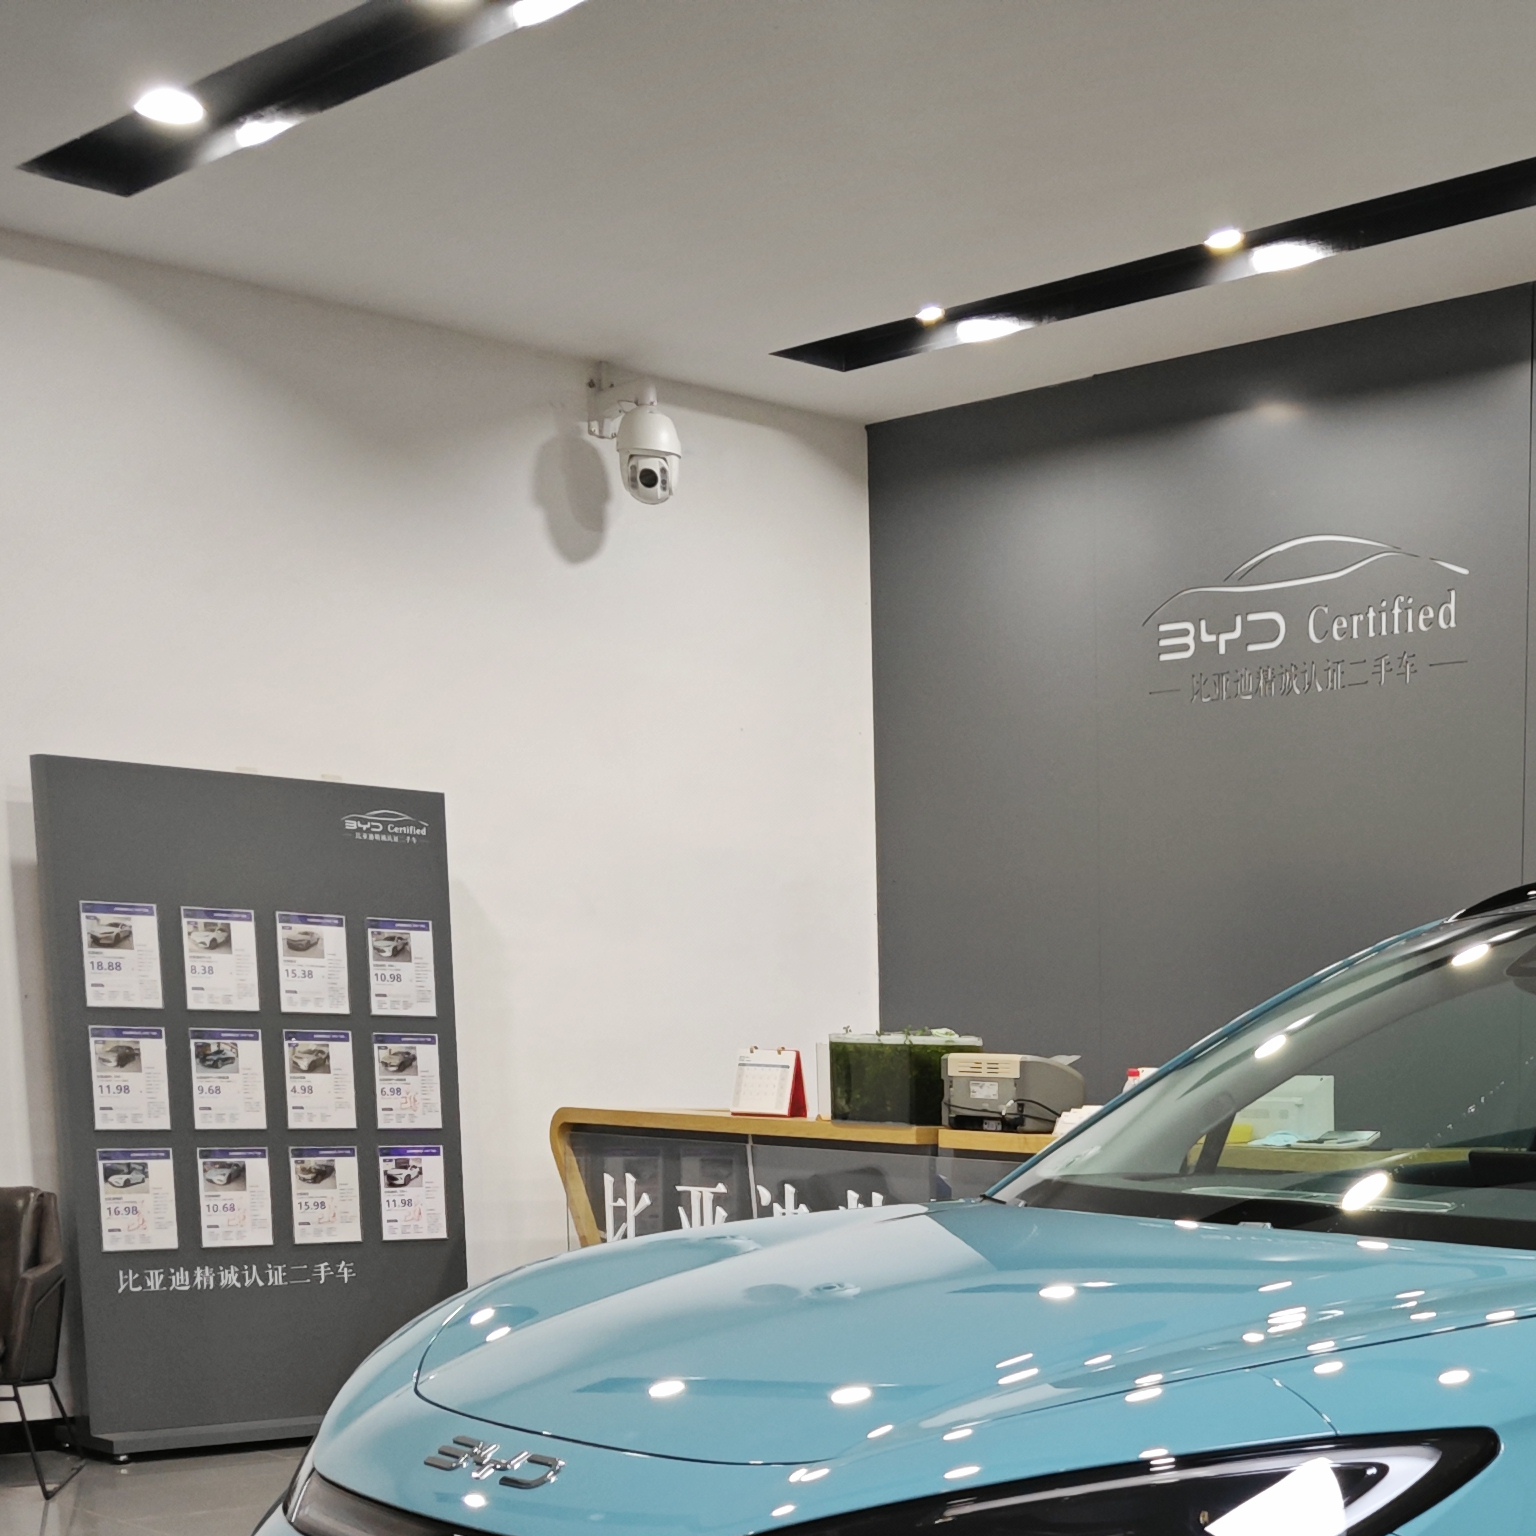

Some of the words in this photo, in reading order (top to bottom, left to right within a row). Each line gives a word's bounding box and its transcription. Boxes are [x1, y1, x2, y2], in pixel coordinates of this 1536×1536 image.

[1158, 611, 1287, 661] BYD
[1307, 588, 1457, 644] Certified
[1190, 650, 1419, 703] 比亚迪精诚认证二手车
[344, 819, 383, 832] BYD
[387, 824, 427, 836] Certified
[89, 960, 122, 972] 18.88
[190, 965, 215, 975] 8.38
[284, 968, 314, 980] 15.38
[373, 972, 402, 983] 10.98
[98, 1084, 131, 1095] 11.98
[197, 1085, 222, 1095] 9.68
[290, 1085, 314, 1095] 4.98
[380, 1087, 402, 1097] 6.98
[205, 1202, 236, 1214] 10.68
[297, 1200, 327, 1211] 15.98
[385, 1198, 413, 1209] 11.98
[106, 1205, 138, 1217] 16.98
[117, 1260, 357, 1294] 比亚迪精诚认证二手车
[424, 1435, 566, 1490] BYD
